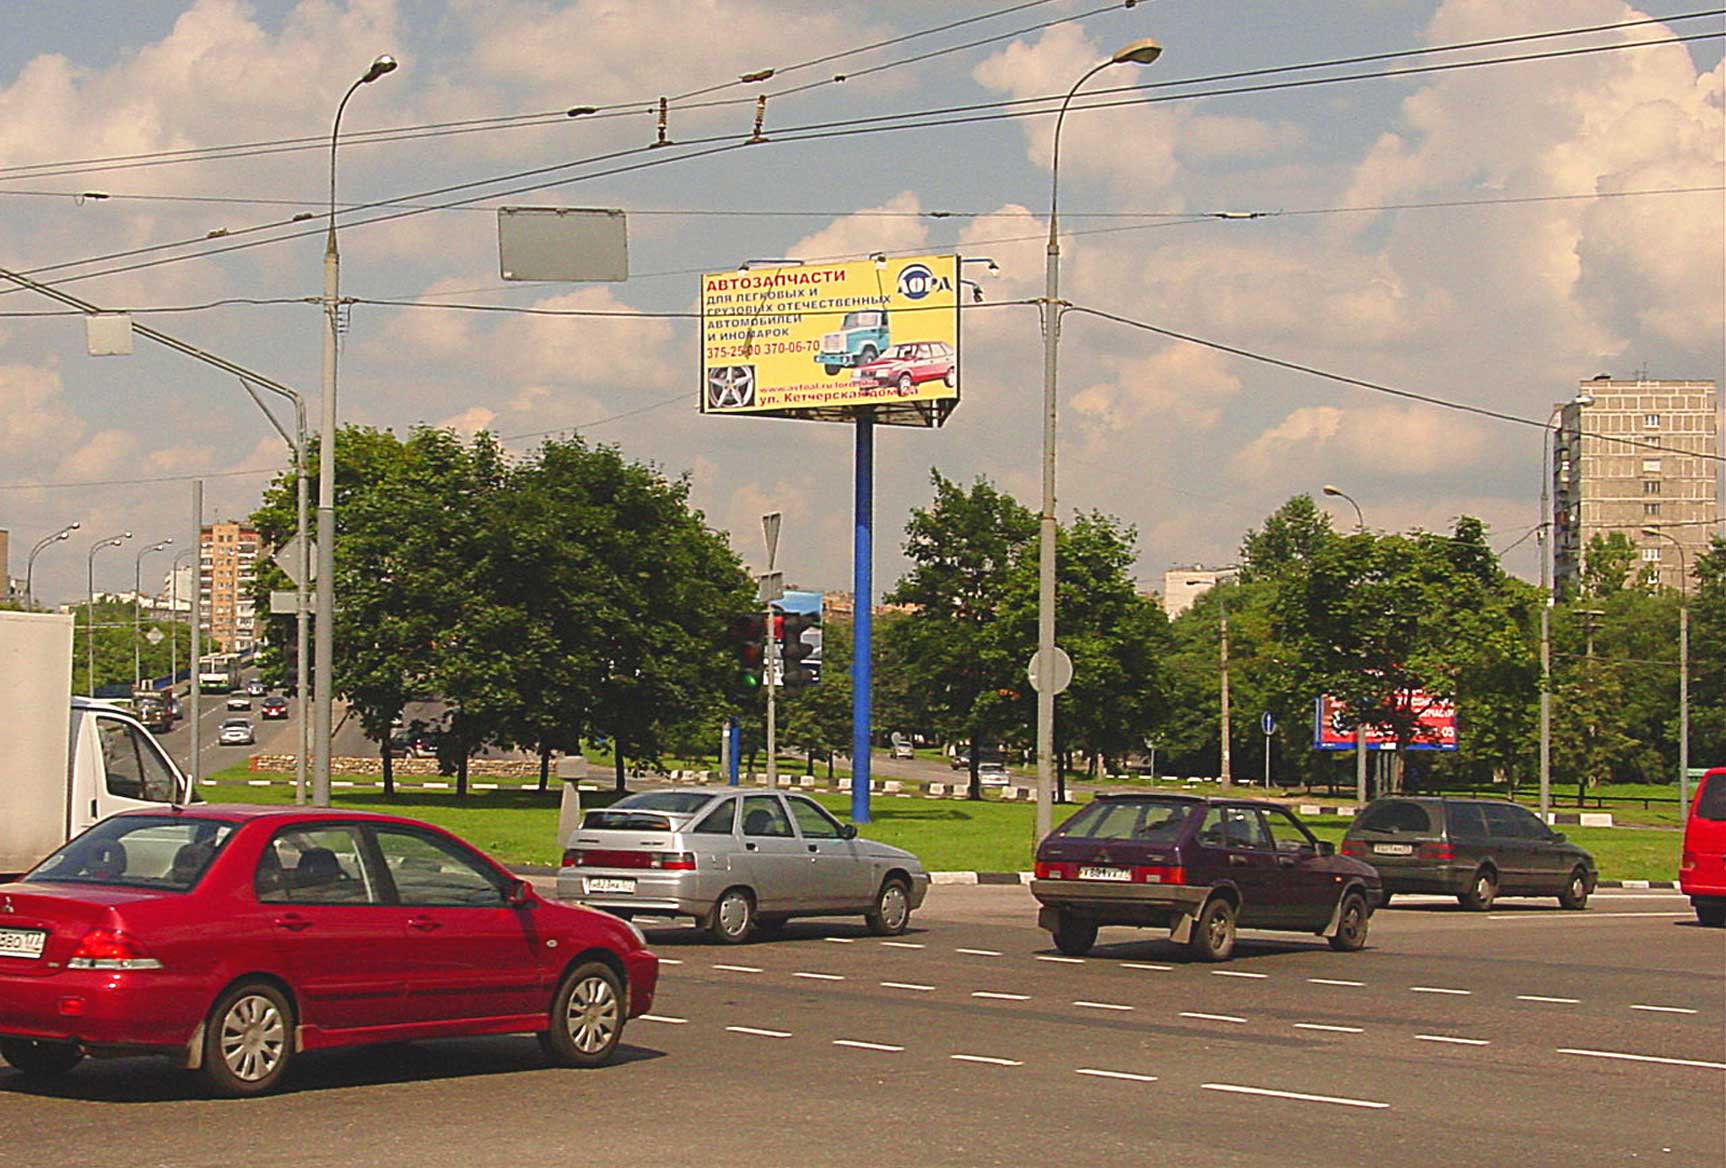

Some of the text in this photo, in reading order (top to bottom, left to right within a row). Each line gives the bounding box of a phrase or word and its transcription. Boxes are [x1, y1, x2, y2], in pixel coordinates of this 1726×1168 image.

[707, 269, 845, 291] АВТОЗАПЧАСТИ
[706, 288, 818, 305] ДЛЯ ЛЕГКОВЫХ И
[707, 295, 892, 316] ГРУЗОВЫХ ОТЕЧЕСТВЕННЫХ
[707, 314, 802, 329] АВТОМОБИЛЕЙ
[707, 328, 789, 341] И ИНОМАРОК
[764, 339, 820, 355] 370-06-70
[759, 395, 779, 406] ул.
[784, 390, 864, 404] Кетчерская
